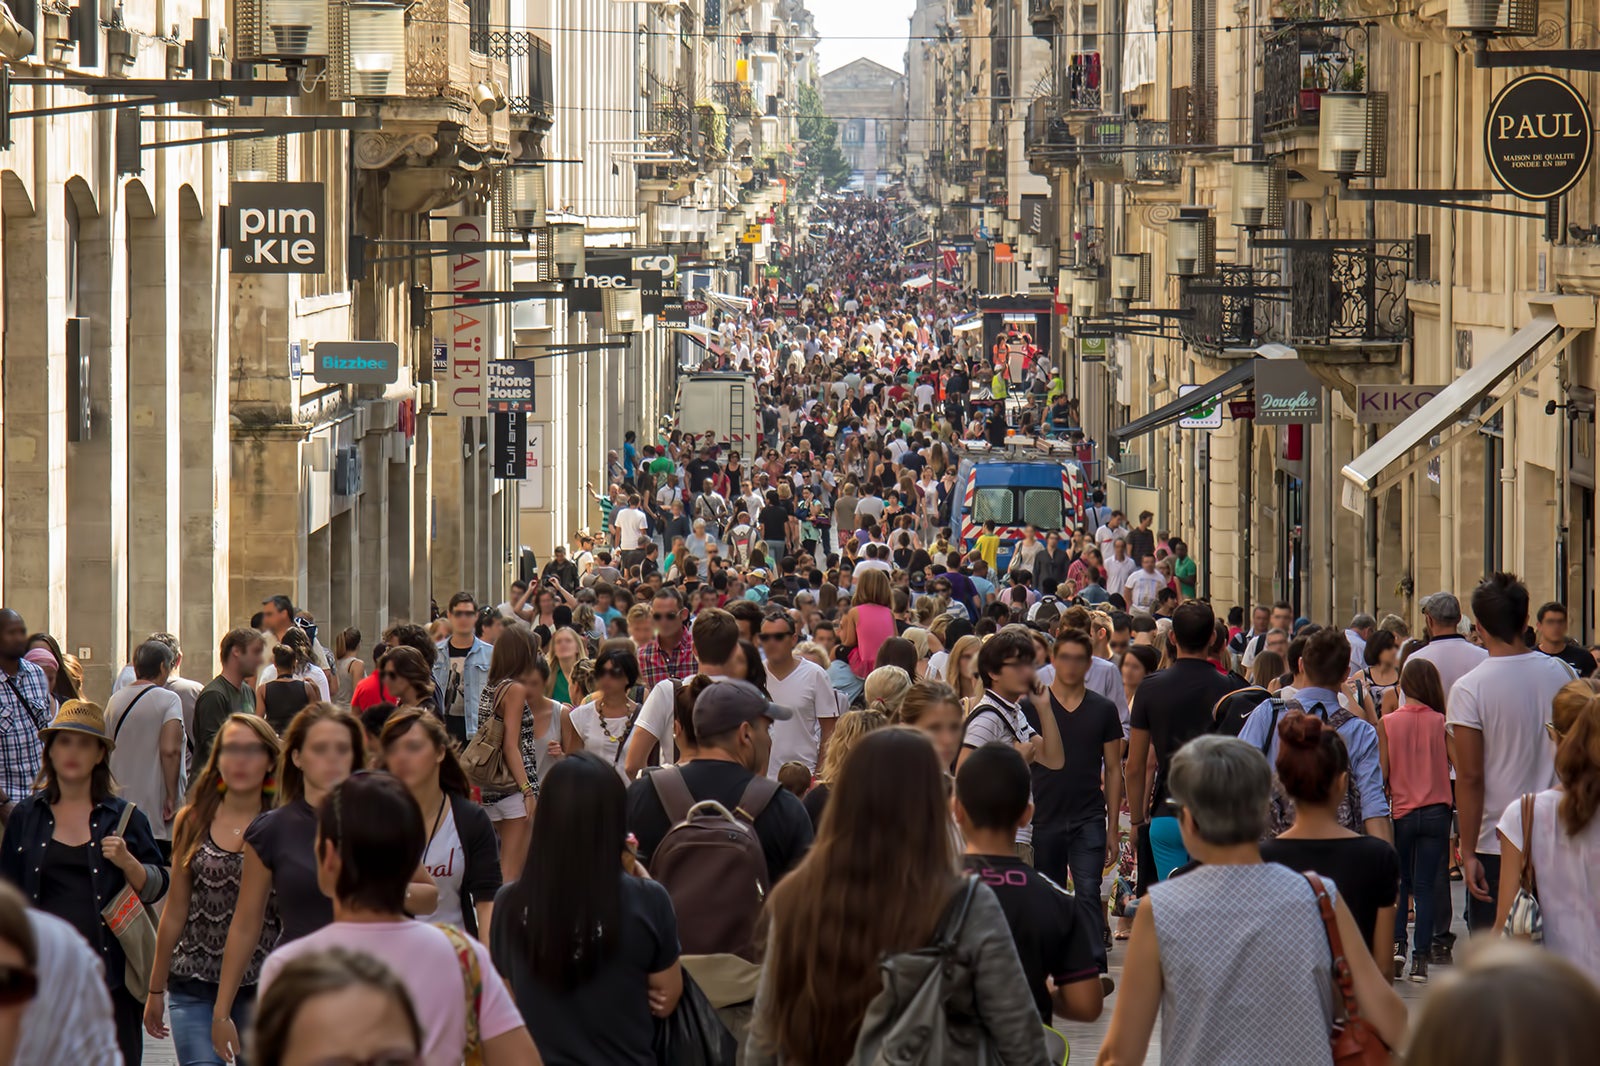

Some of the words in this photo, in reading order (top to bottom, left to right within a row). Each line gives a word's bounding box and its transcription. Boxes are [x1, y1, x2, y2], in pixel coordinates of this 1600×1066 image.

[1497, 113, 1582, 139] PAUL
[1503, 154, 1531, 162] MAISON
[1532, 153, 1543, 161] DE
[1544, 153, 1576, 161] QUALITE
[240, 207, 316, 243] pim
[1030, 203, 1042, 233] tam
[322, 355, 389, 370] Bizzbee
[488, 363, 515, 376] The
[488, 376, 532, 387] Phone
[488, 388, 532, 399] House
[1261, 390, 1318, 411] Douglas
[506, 445, 516, 476] Pull
